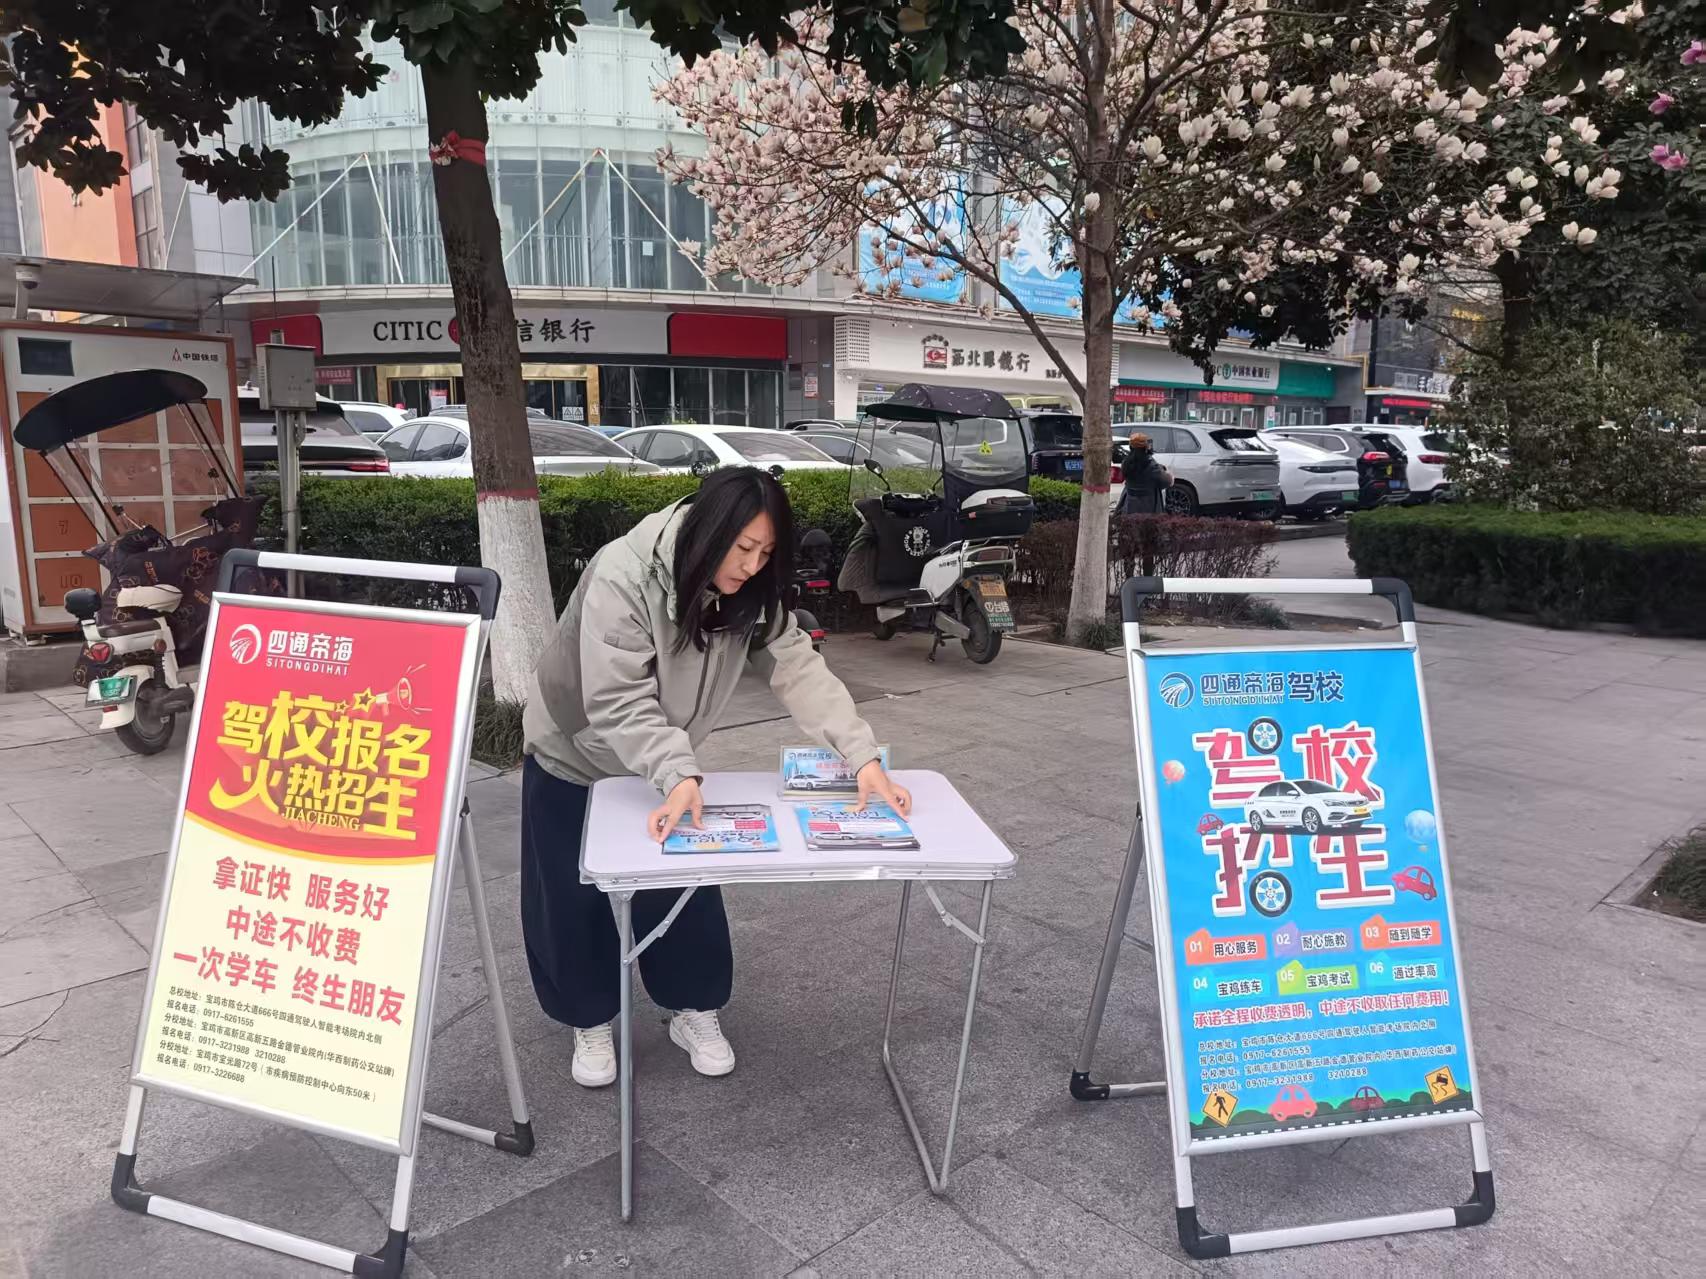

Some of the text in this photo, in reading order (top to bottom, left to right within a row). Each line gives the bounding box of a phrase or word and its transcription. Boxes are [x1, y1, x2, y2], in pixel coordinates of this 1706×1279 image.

[373, 320, 443, 342] CITIC
[515, 318, 596, 343] 信银行
[182, 351, 219, 363] 中国铁塔
[951, 348, 1031, 373] 西北眼镜行
[266, 629, 354, 662] 四通帝海
[266, 657, 350, 676] SITONGDIHAI
[1202, 694, 1285, 705] SITONGDIHAI
[216, 690, 432, 779] 驾校报名
[1194, 721, 1384, 806] 驾校
[208, 759, 418, 841] 火热招生
[281, 806, 361, 832] JIACHENG
[1204, 824, 1393, 911] 招生
[212, 856, 390, 922] 拿证快 服务好
[226, 905, 362, 966] 中途不收费
[1190, 926, 1433, 957] 01 用心服务 02 耐心施教 03 随到随学
[173, 946, 406, 1026] 一次学车 终生朋友
[1193, 962, 1437, 996] 04 宝鸡练车 05 宝鸡考试 06 通过率高
[254, 1049, 287, 1065] 3210288
[1328, 1067, 1368, 1080] 3210288
